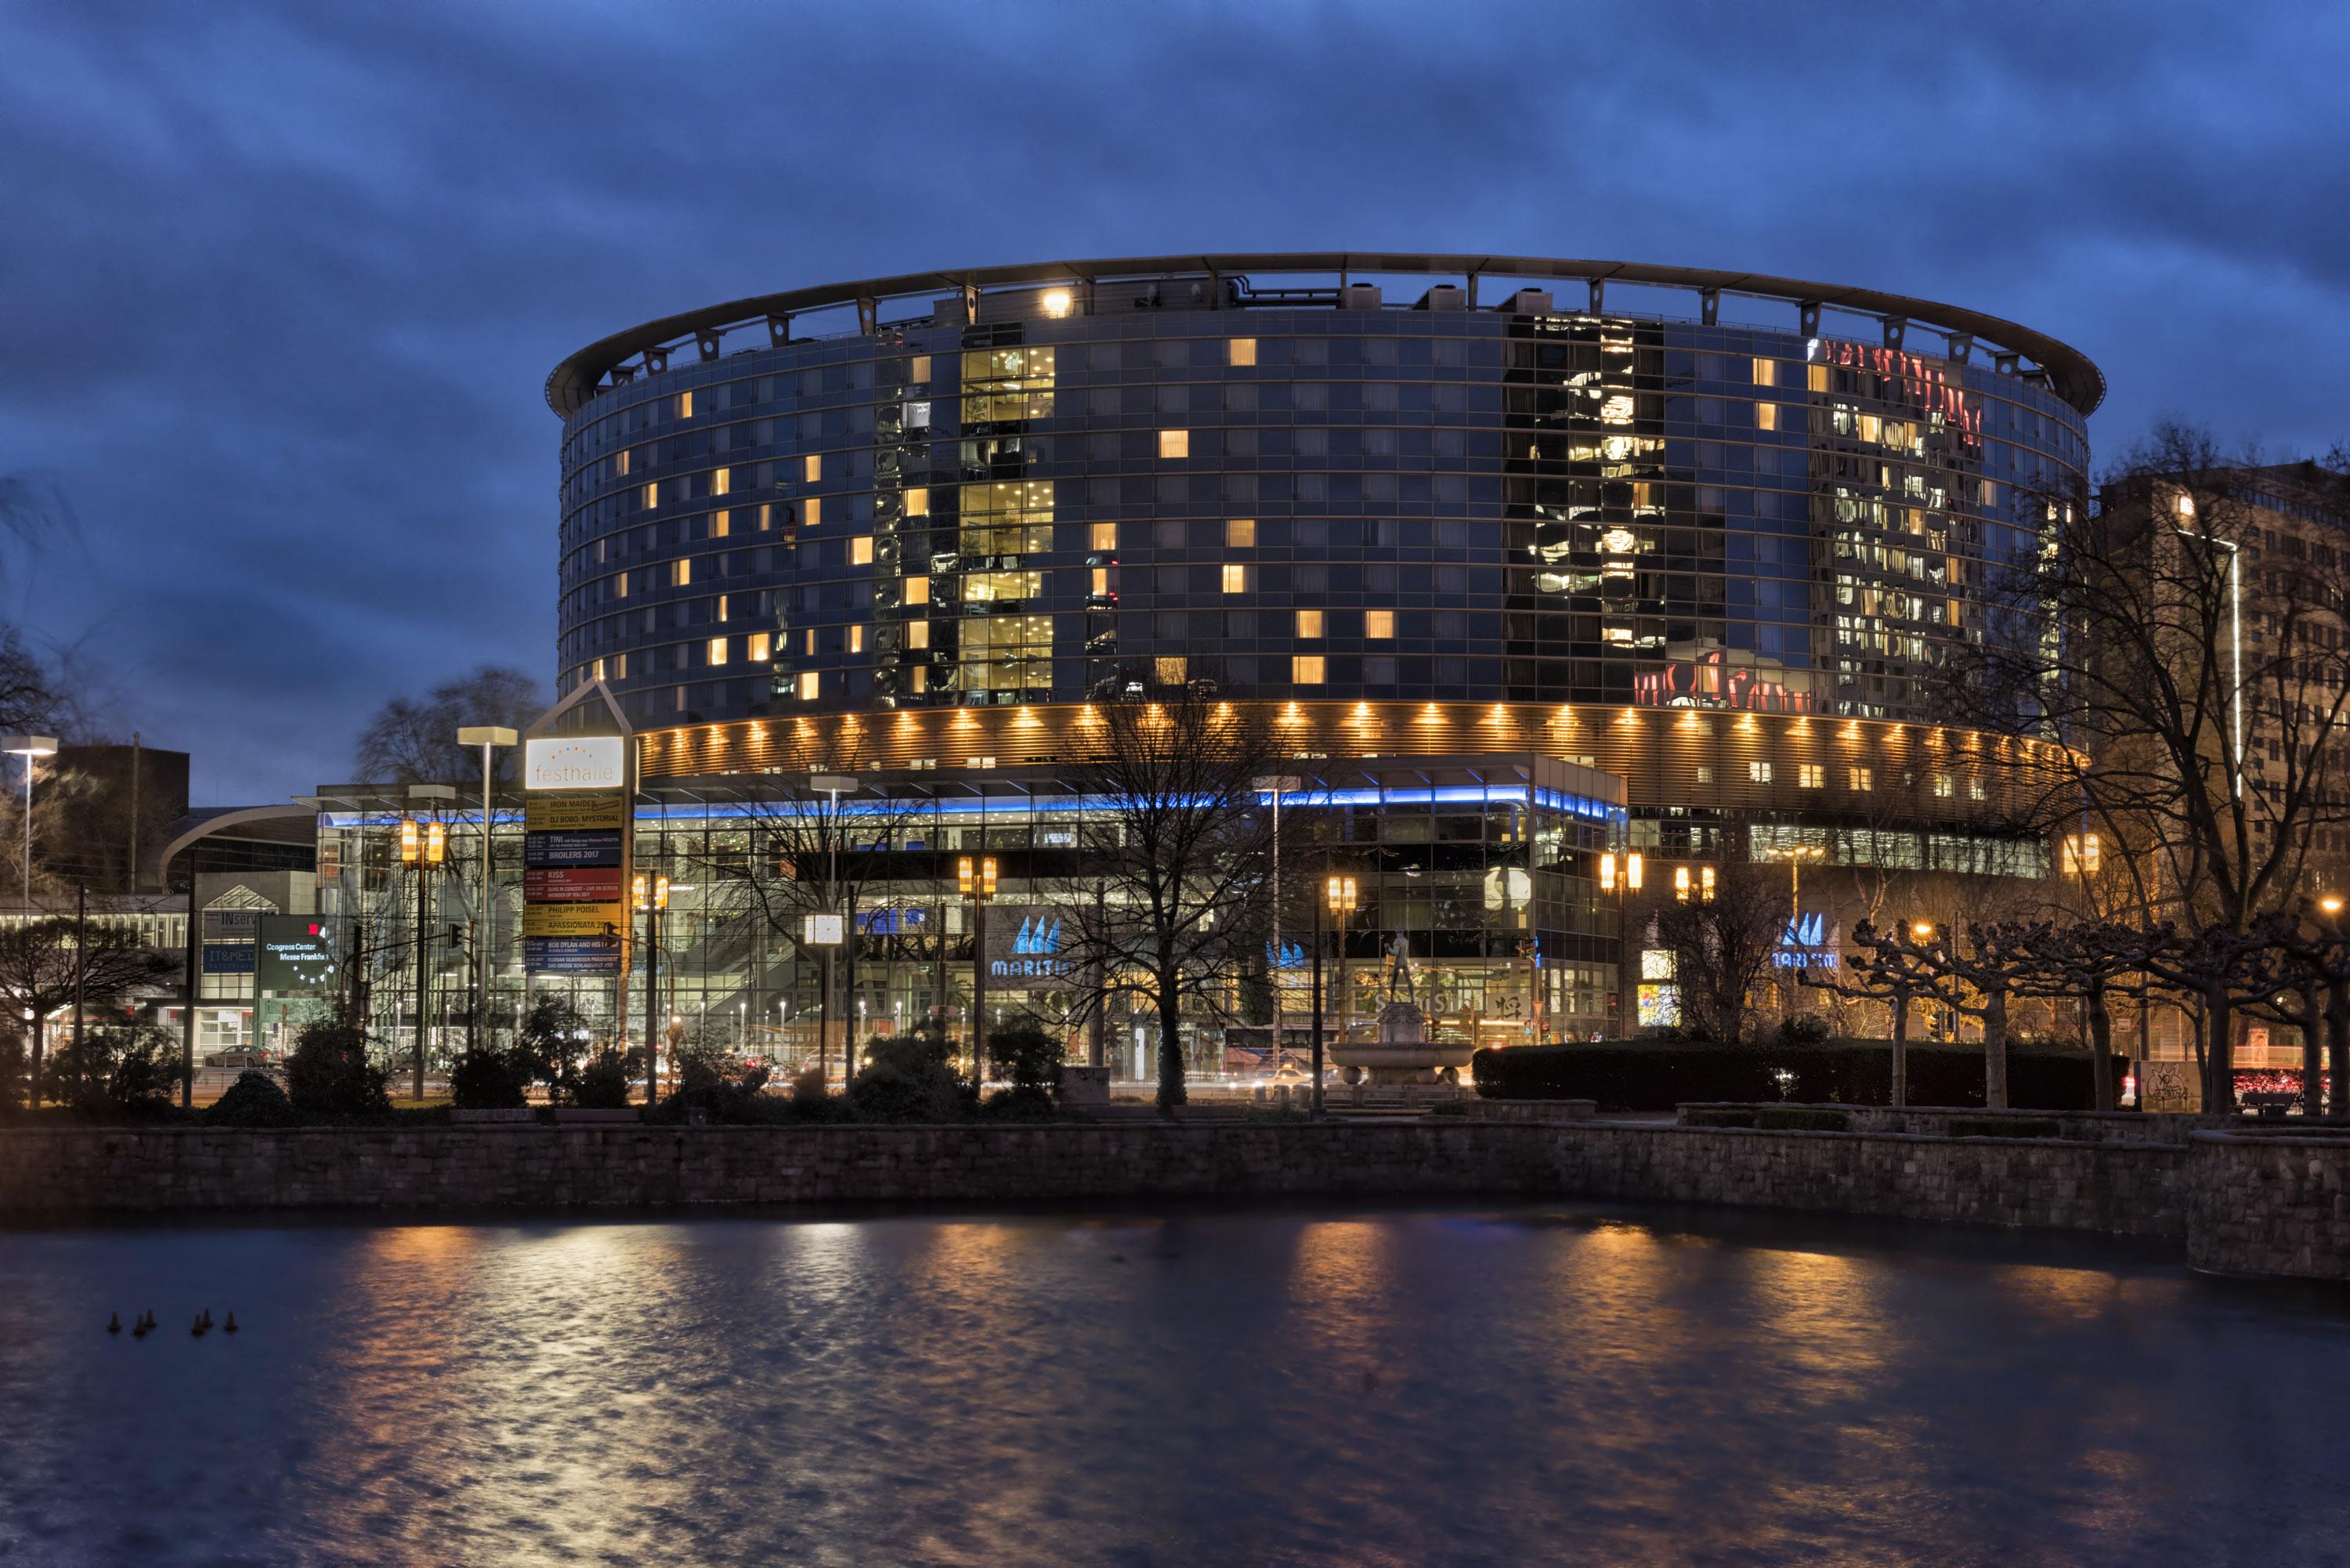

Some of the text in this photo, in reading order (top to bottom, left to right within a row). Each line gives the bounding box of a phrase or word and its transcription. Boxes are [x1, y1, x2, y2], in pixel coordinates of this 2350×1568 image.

[536, 764, 613, 782] festhalle
[550, 800, 567, 809] IRON
[569, 799, 597, 808] MAIDEN
[266, 943, 295, 952] Congress
